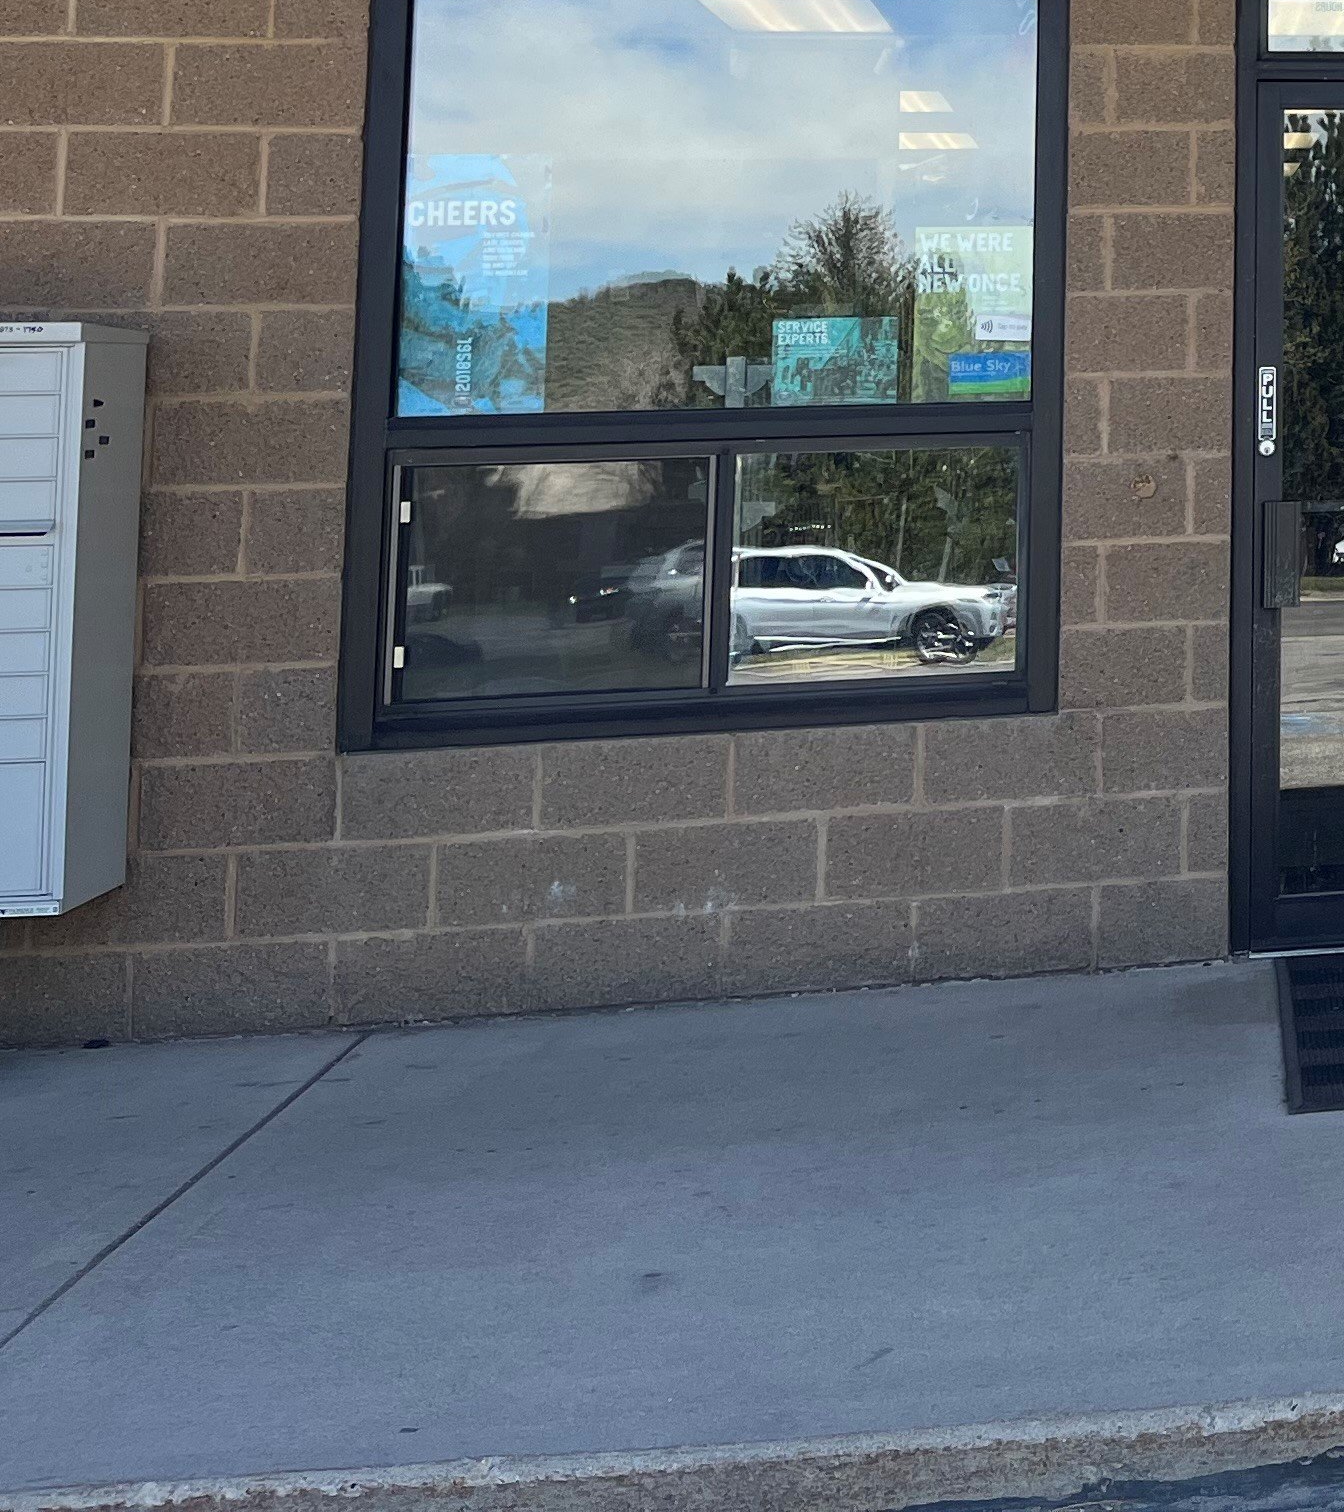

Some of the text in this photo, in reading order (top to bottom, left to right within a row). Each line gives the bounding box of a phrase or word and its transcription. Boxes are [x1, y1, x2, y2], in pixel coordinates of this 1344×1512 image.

[408, 200, 517, 227] CHEERS
[919, 232, 1014, 252] WE WERE
[918, 252, 958, 273] ALL
[918, 272, 1022, 293] NEW ONCE
[777, 321, 828, 333] SERVICE
[951, 358, 1012, 373] Blue Sky
[1262, 373, 1273, 423] PULL
